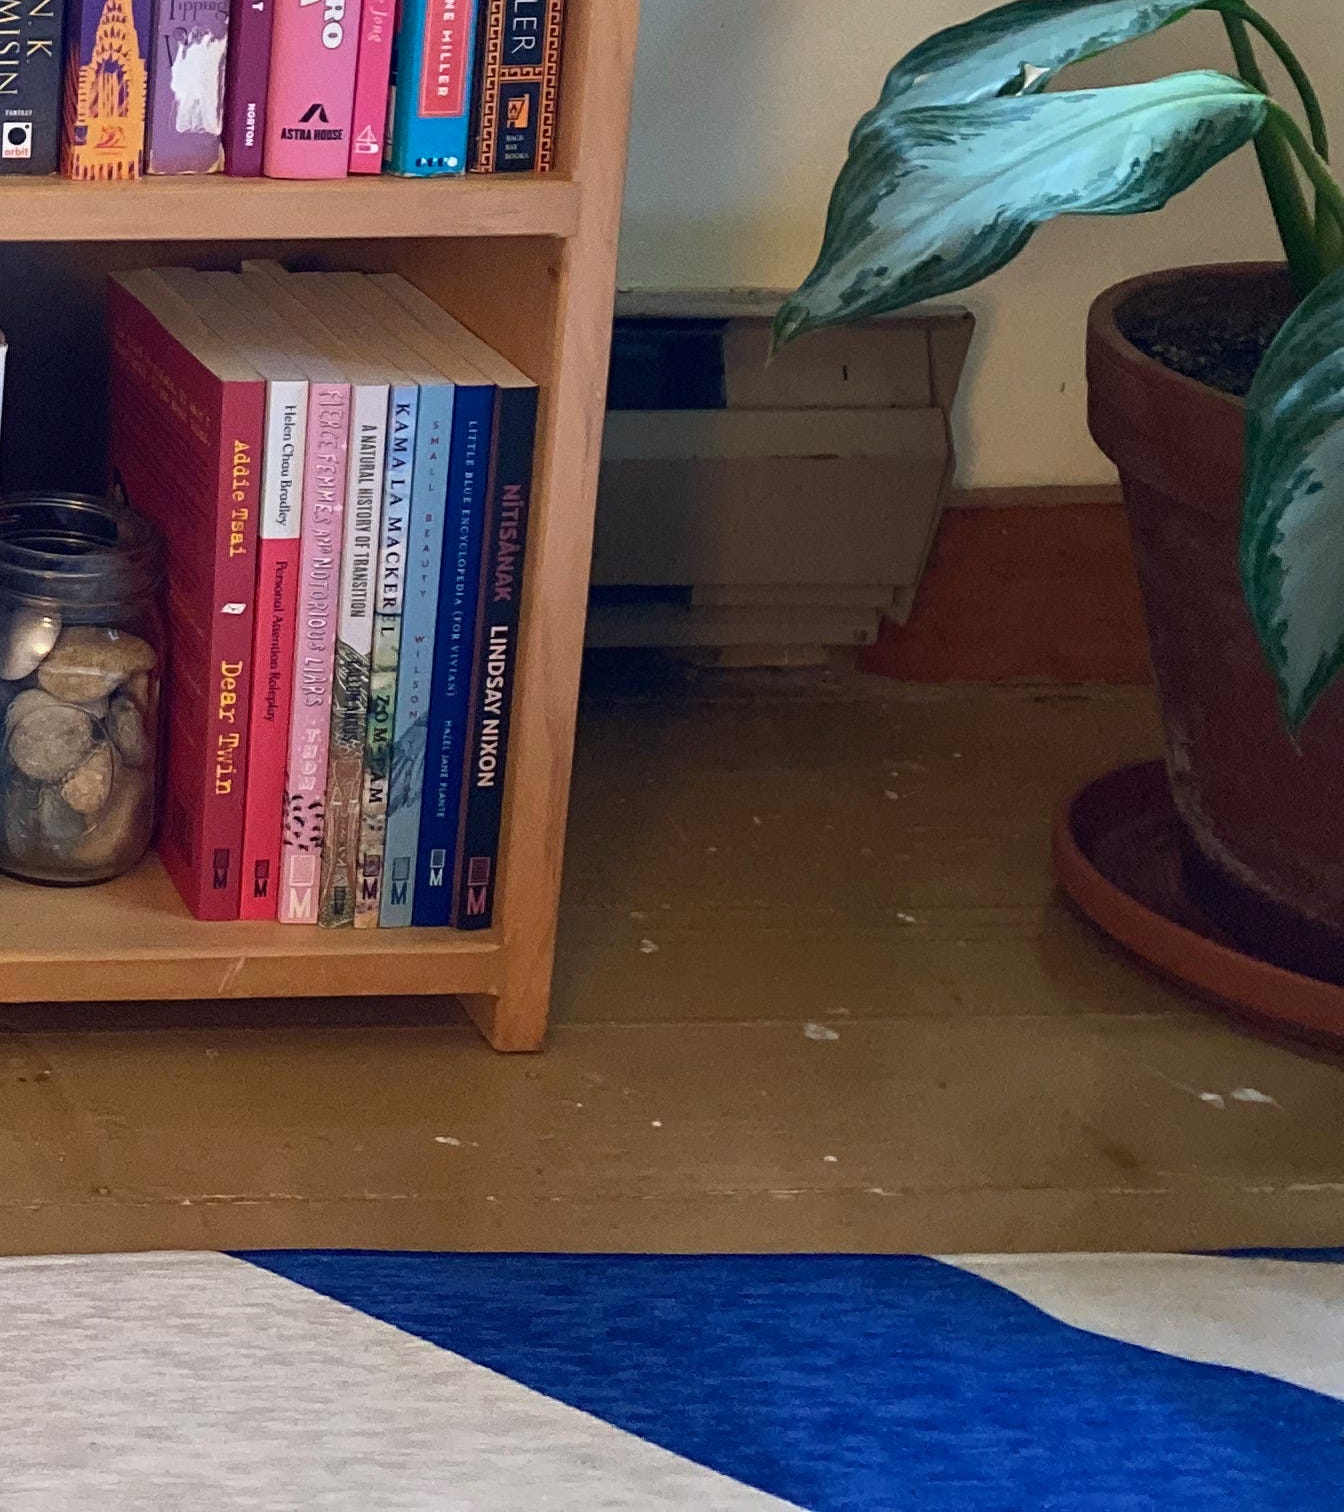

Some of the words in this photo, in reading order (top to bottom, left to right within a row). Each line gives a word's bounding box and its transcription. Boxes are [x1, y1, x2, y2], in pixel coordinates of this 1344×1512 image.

[4, 146, 30, 157] orbit
[245, 103, 256, 146] NORTON
[220, 660, 243, 724] Dear
[482, 624, 508, 715] LINDSAY
[215, 732, 241, 794] Twin
[476, 717, 504, 789] NIXON
